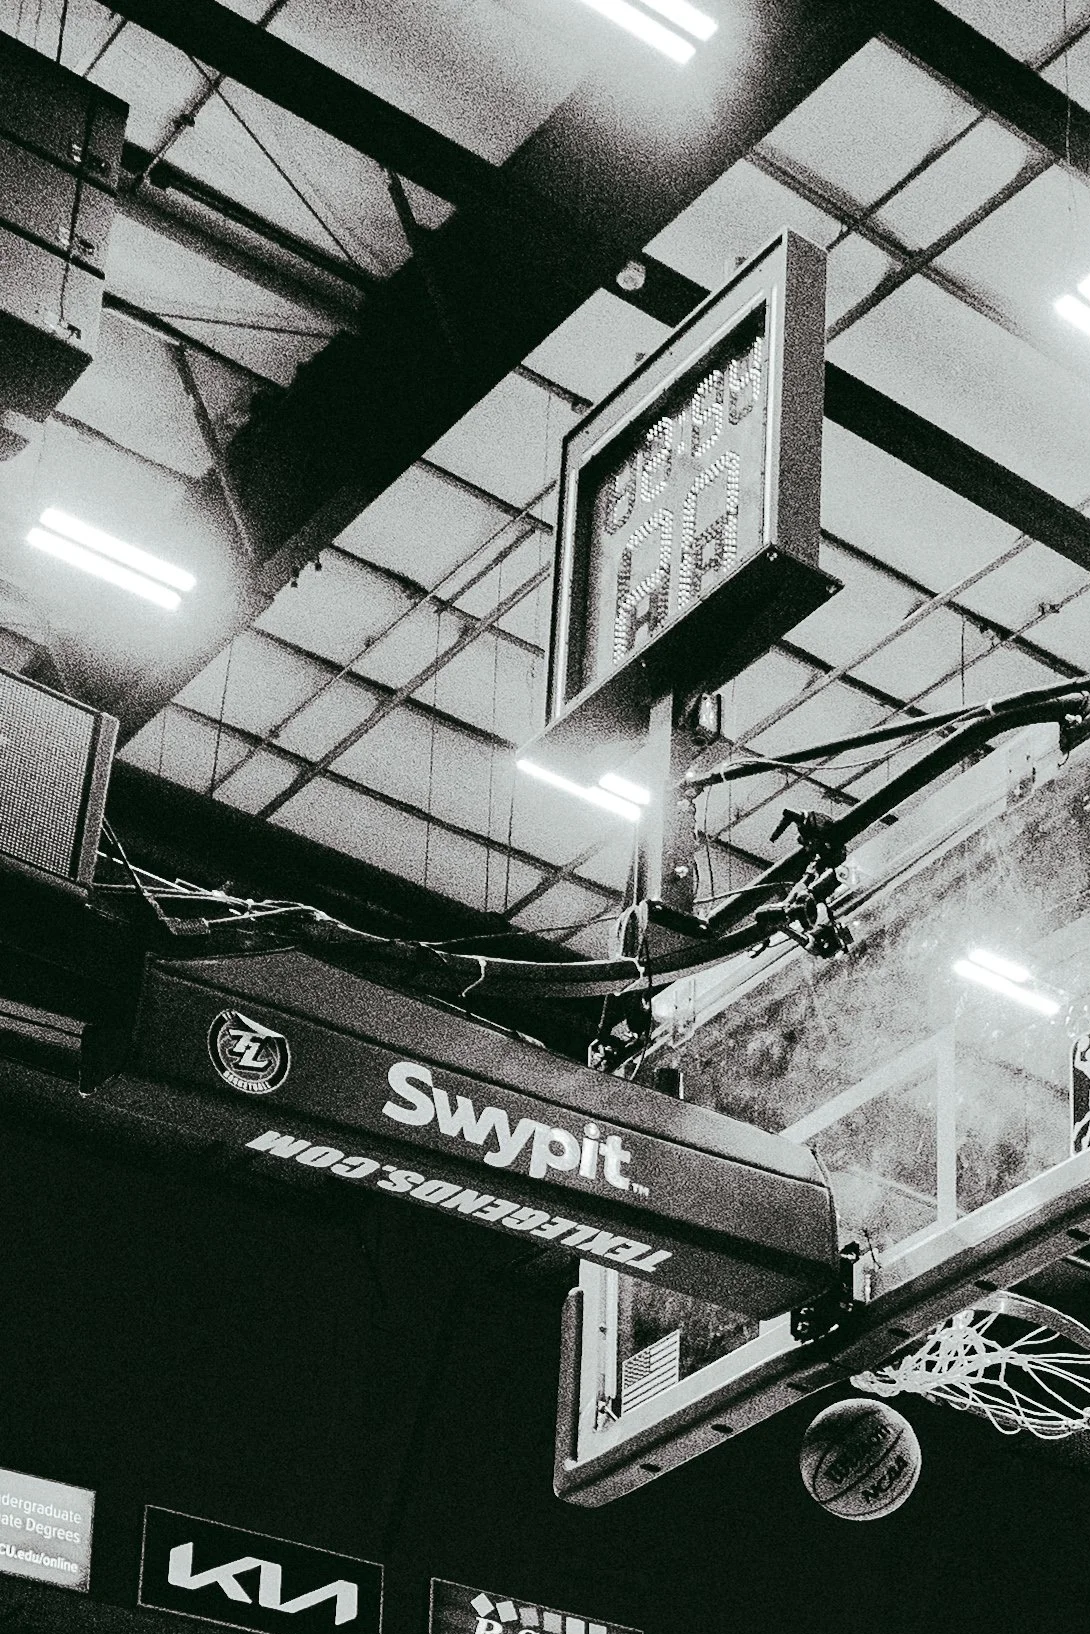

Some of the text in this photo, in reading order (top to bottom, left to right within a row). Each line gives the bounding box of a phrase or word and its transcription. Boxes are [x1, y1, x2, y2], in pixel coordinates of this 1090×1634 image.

[382, 1061, 632, 1190] Swypit
[244, 1130, 673, 1273] TEXLEGENDS.COM
[25, 1517, 81, 1543] Degrees
[168, 1541, 359, 1626] KIA
